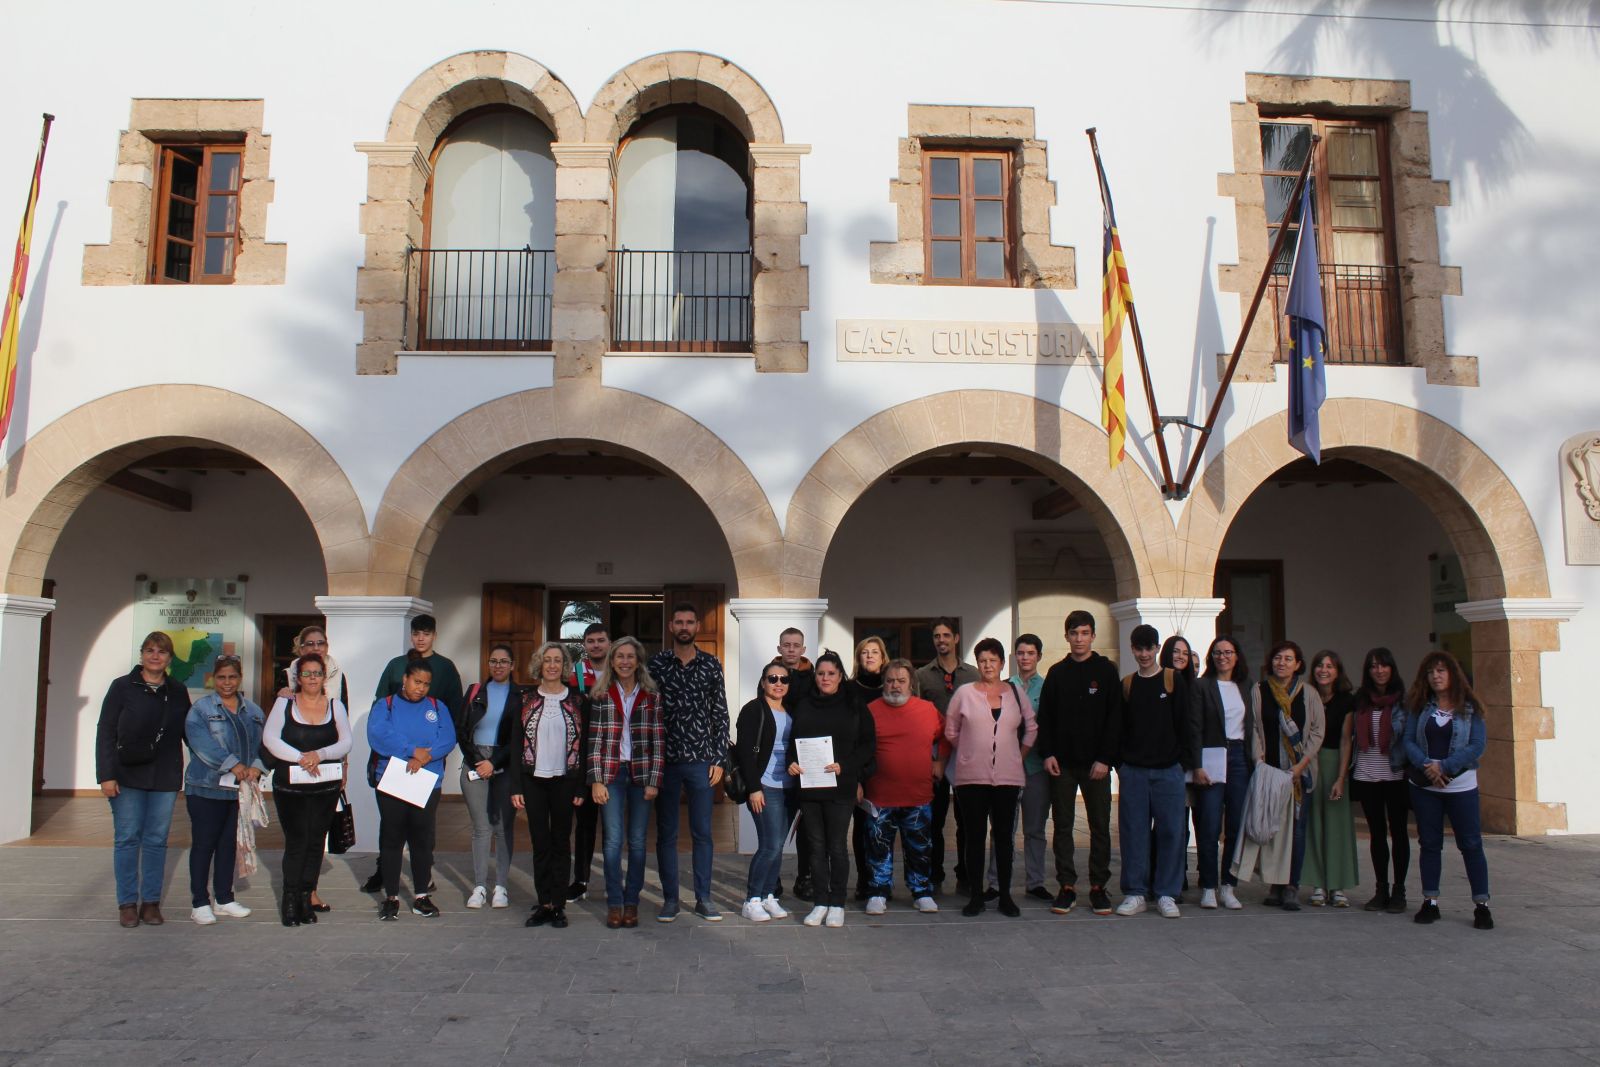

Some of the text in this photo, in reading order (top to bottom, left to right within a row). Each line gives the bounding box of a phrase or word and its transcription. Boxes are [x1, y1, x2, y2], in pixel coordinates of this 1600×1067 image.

[844, 327, 916, 355] CASA
[182, 608, 189, 616] DE
[190, 608, 205, 616] SANTA
